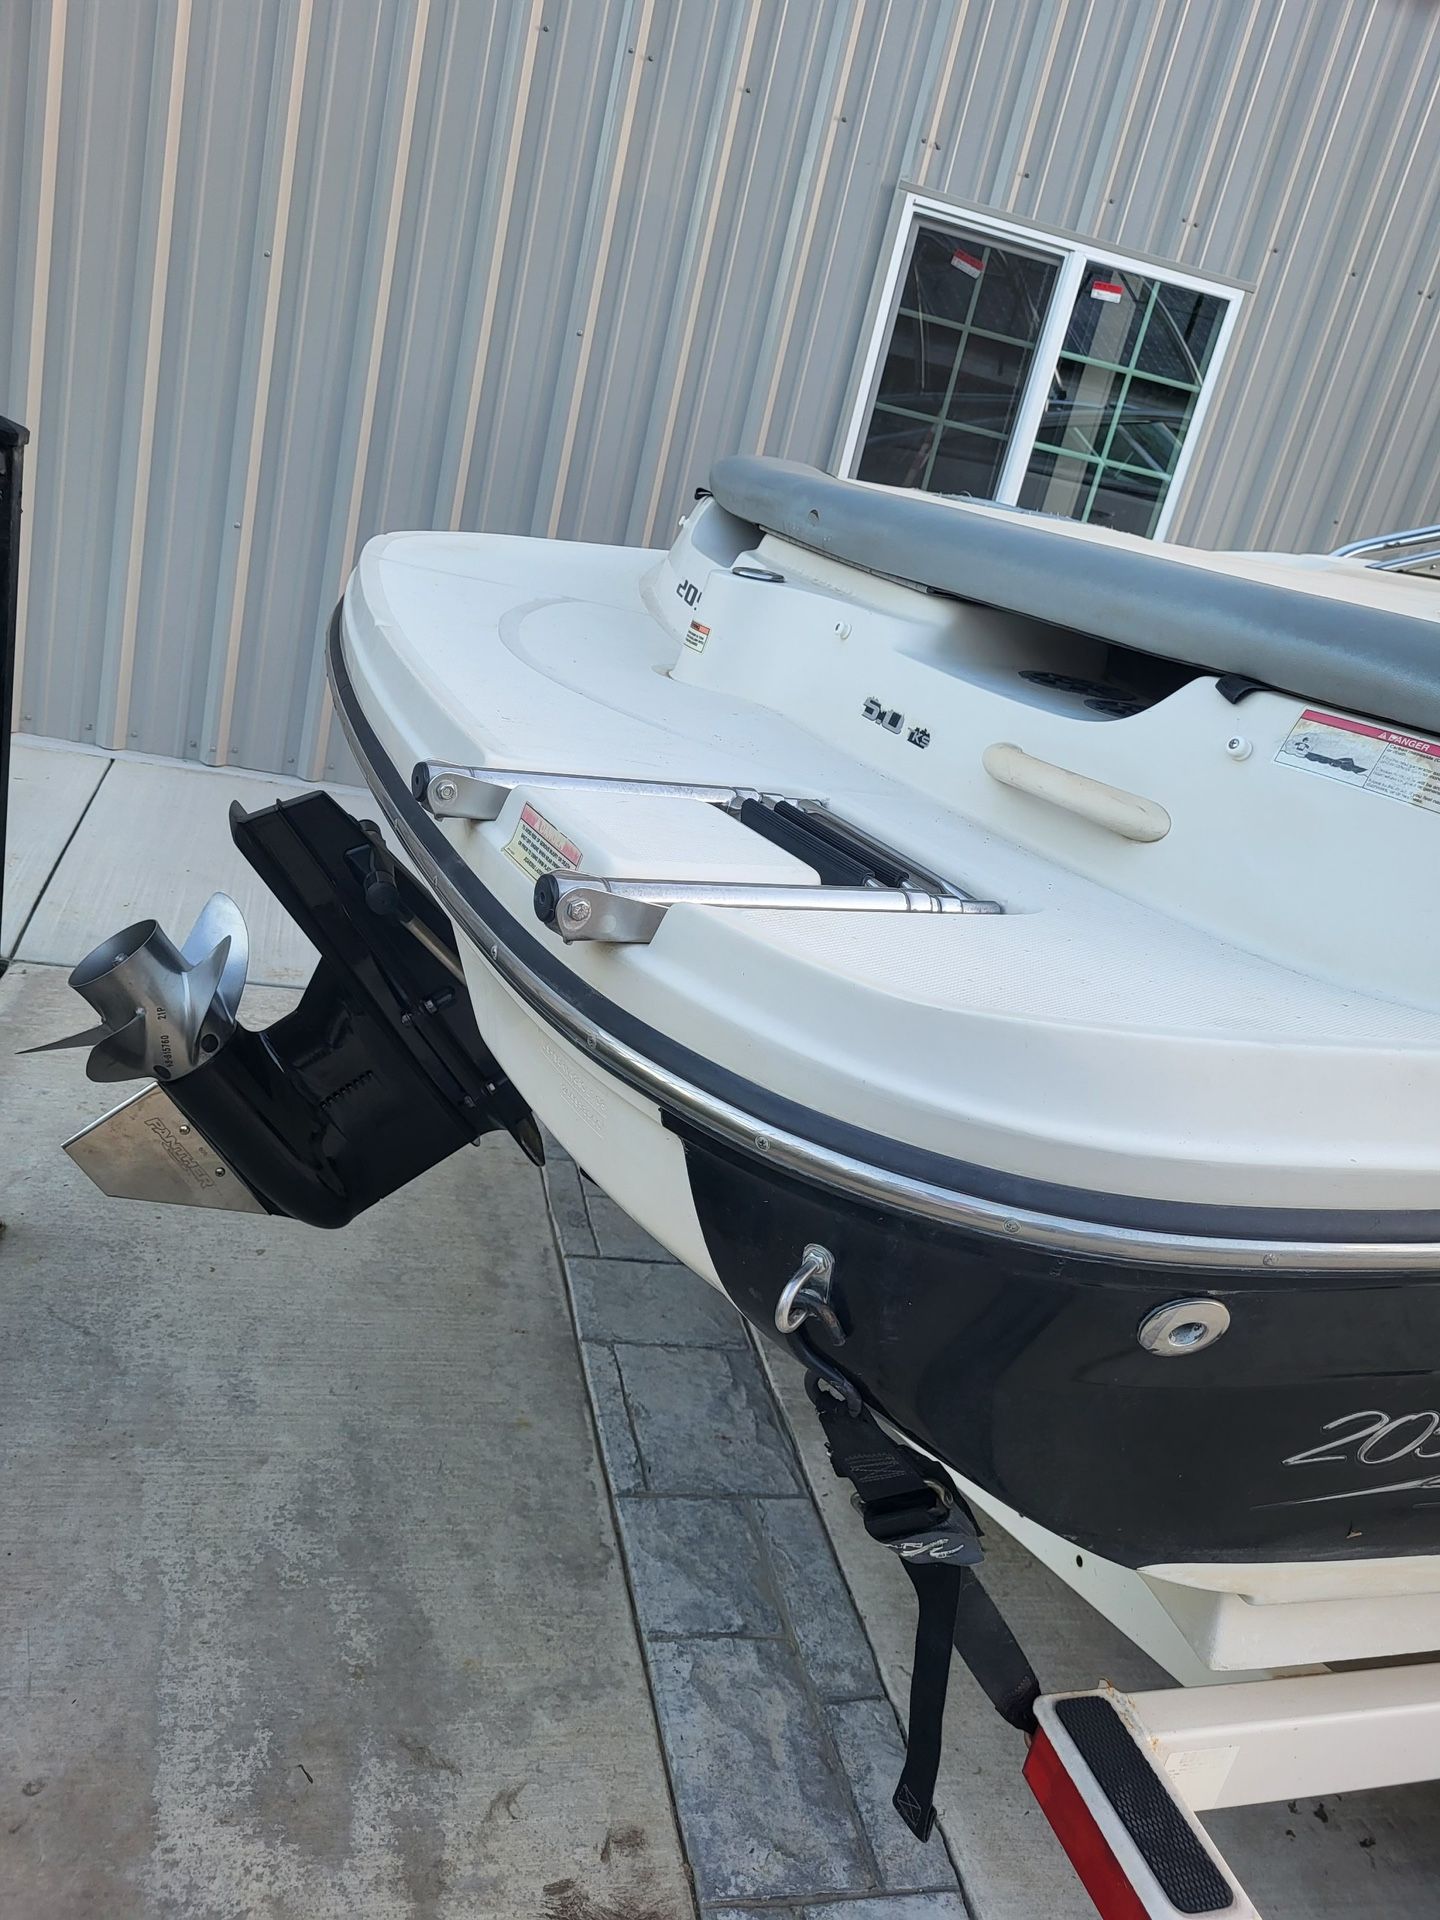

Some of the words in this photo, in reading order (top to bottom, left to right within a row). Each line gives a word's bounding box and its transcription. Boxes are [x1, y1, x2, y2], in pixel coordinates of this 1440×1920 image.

[861, 696, 905, 735] 5.0
[1388, 734, 1430, 752] DANGER
[144, 1117, 215, 1188] PANTHER
